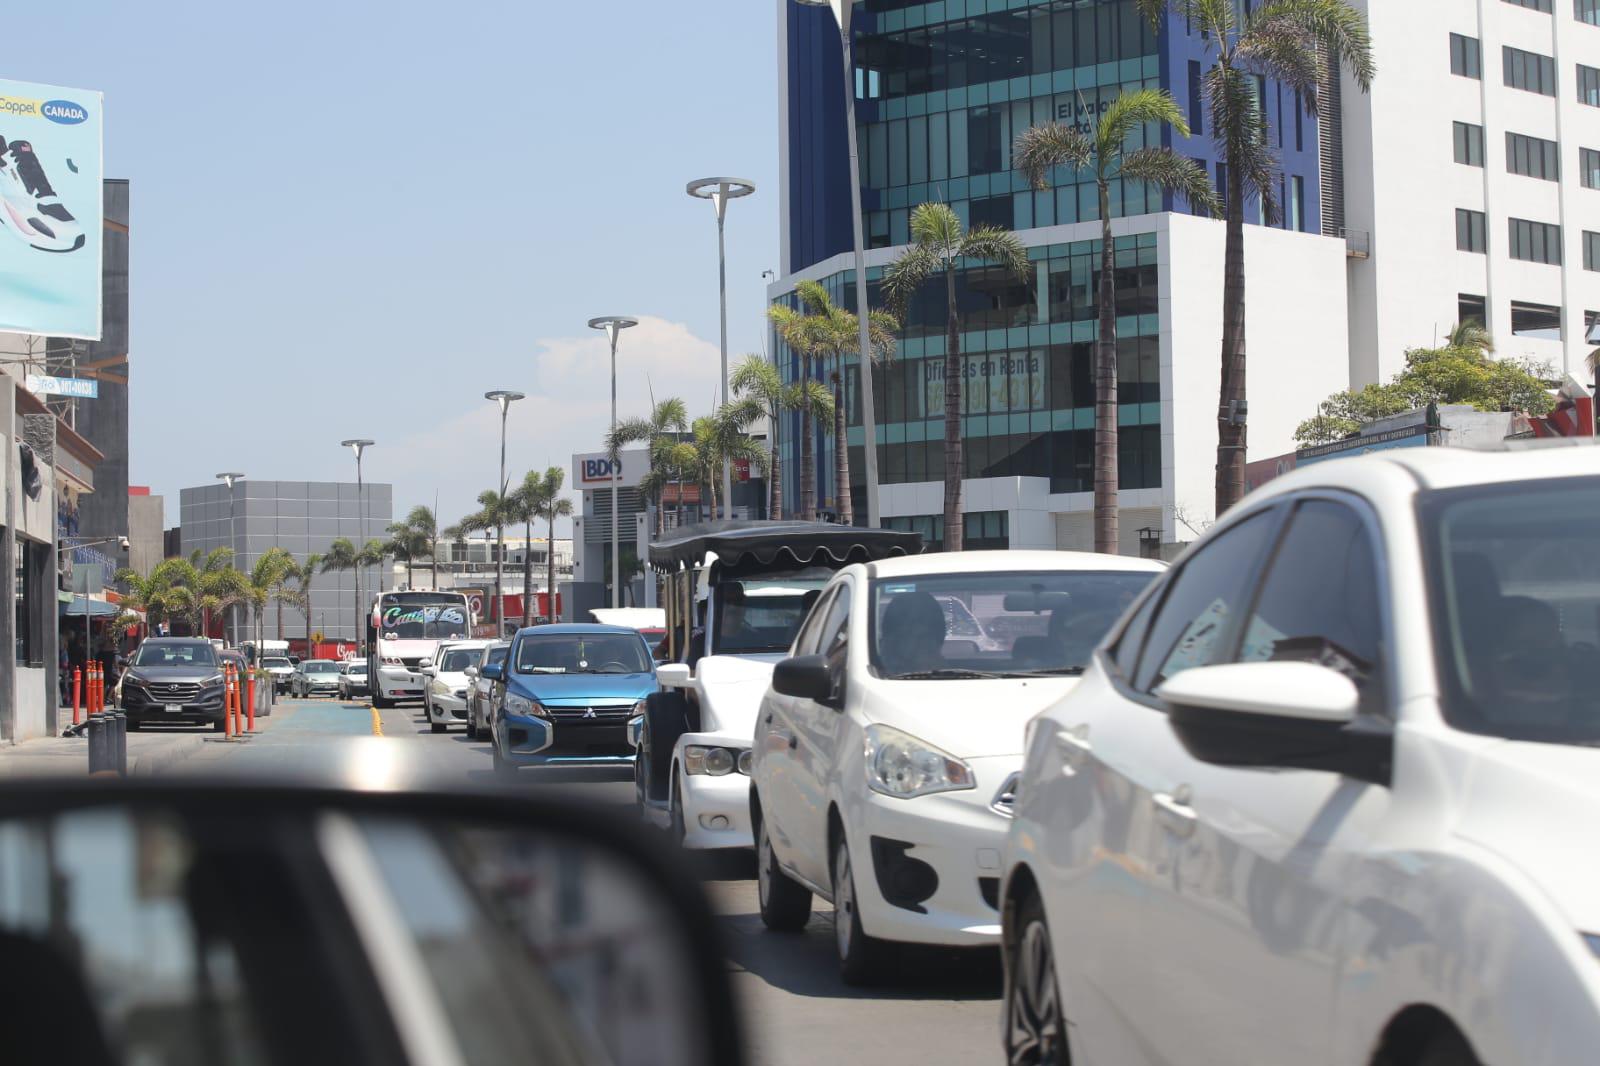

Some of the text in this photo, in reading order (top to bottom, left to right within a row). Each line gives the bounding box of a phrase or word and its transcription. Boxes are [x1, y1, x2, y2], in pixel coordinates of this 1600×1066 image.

[0, 97, 36, 115] Coppel
[44, 104, 85, 120] CANADA
[1058, 102, 1071, 119] El
[999, 355, 1039, 375] Renta
[586, 458, 622, 477] BDO
